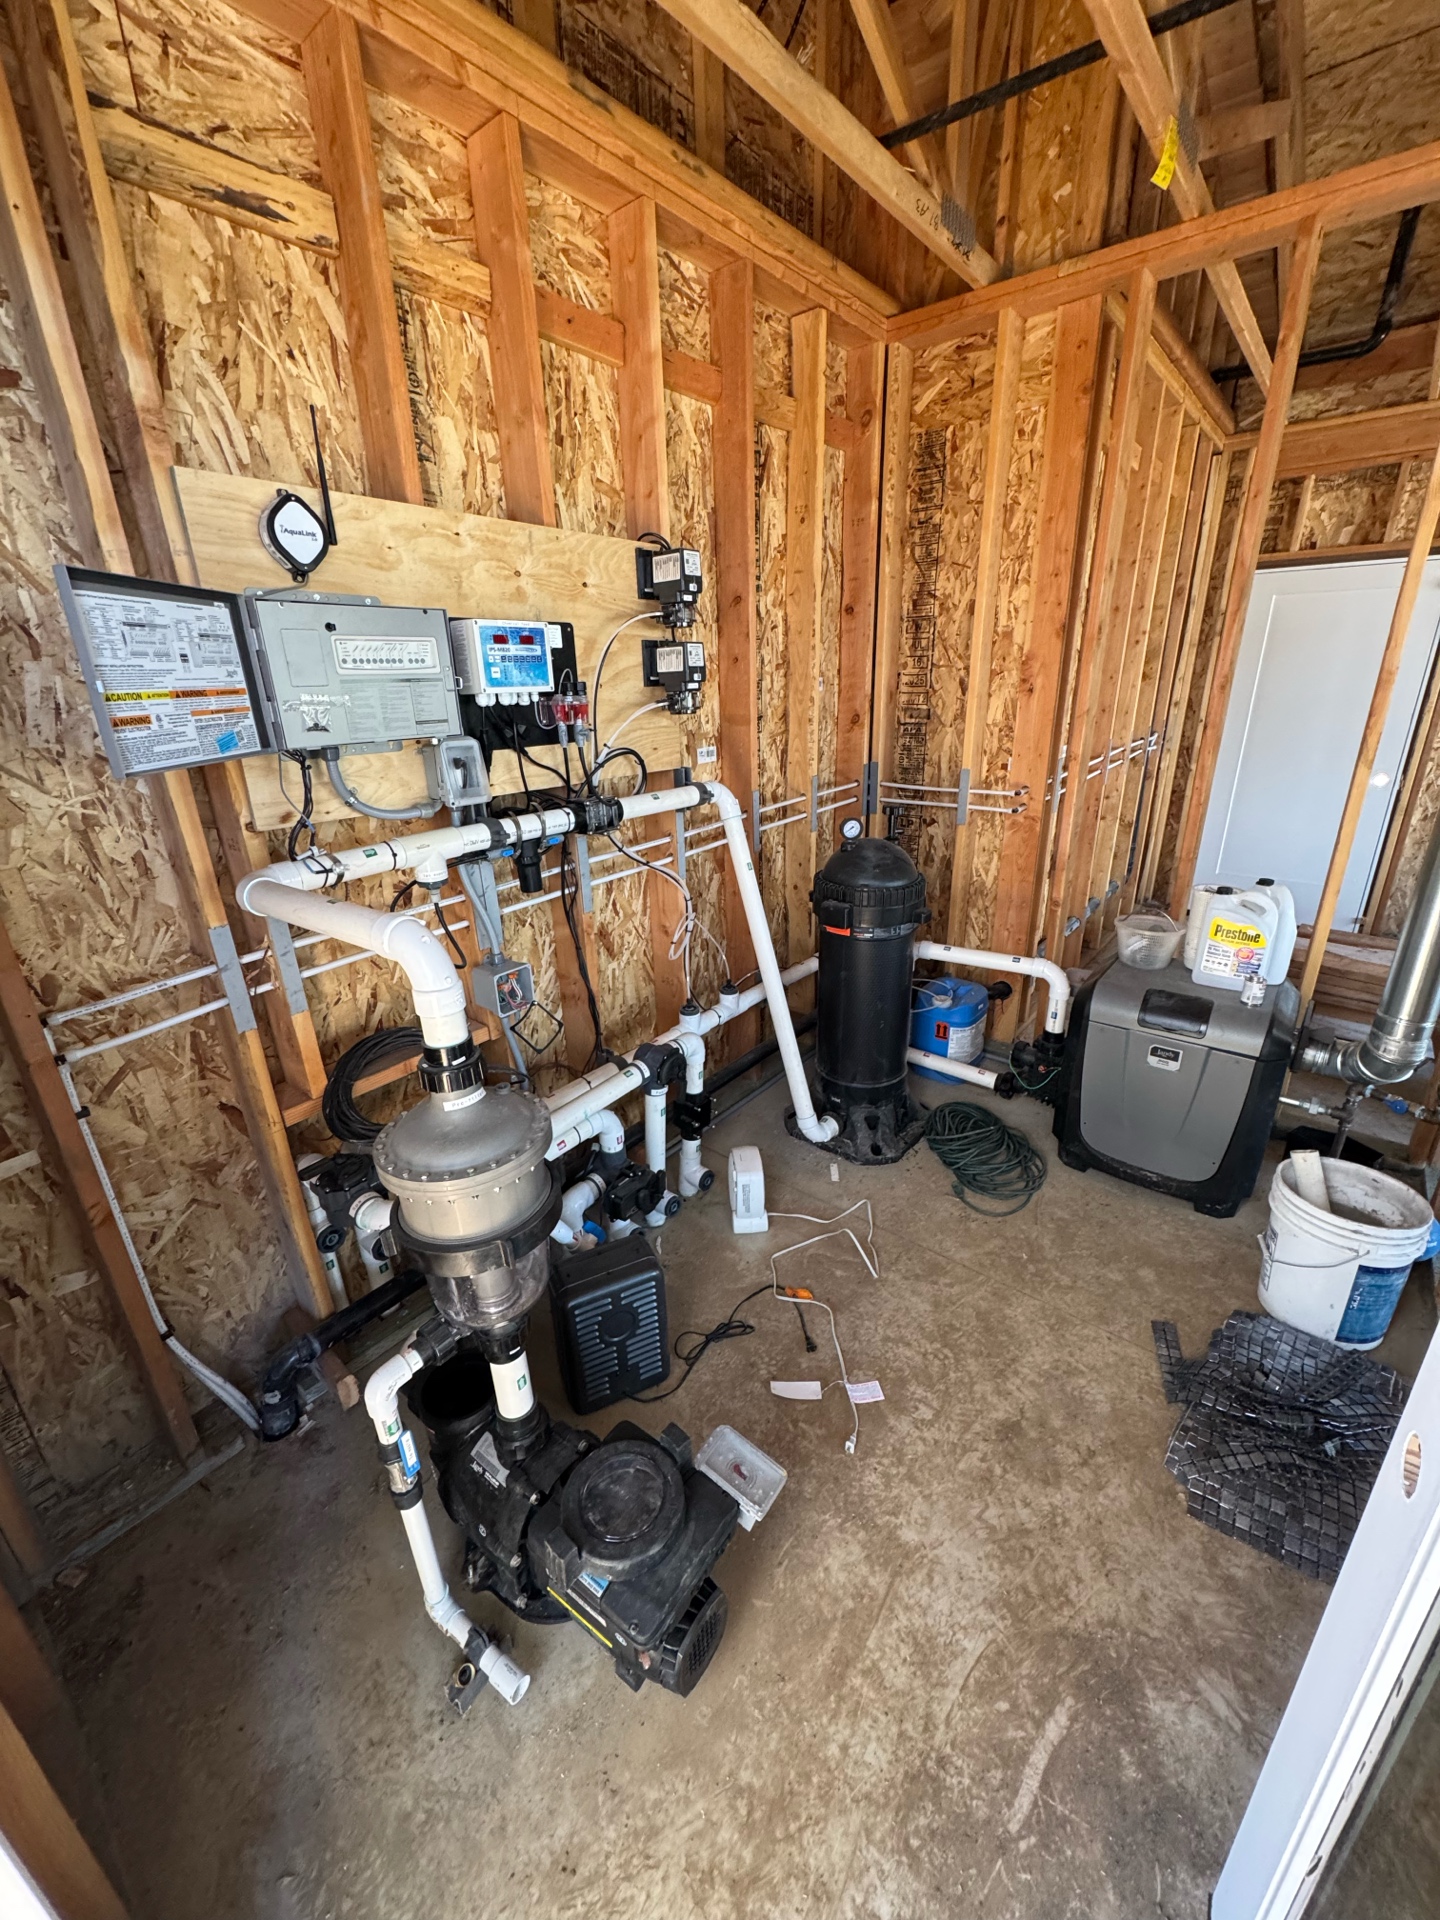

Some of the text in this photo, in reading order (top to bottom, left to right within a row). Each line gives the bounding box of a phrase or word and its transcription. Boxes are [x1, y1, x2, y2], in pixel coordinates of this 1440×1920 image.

[110, 692, 143, 702] CAUTION
[180, 690, 208, 698] WARNING
[119, 716, 151, 726] WARNING
[1213, 924, 1261, 944] Prestone
